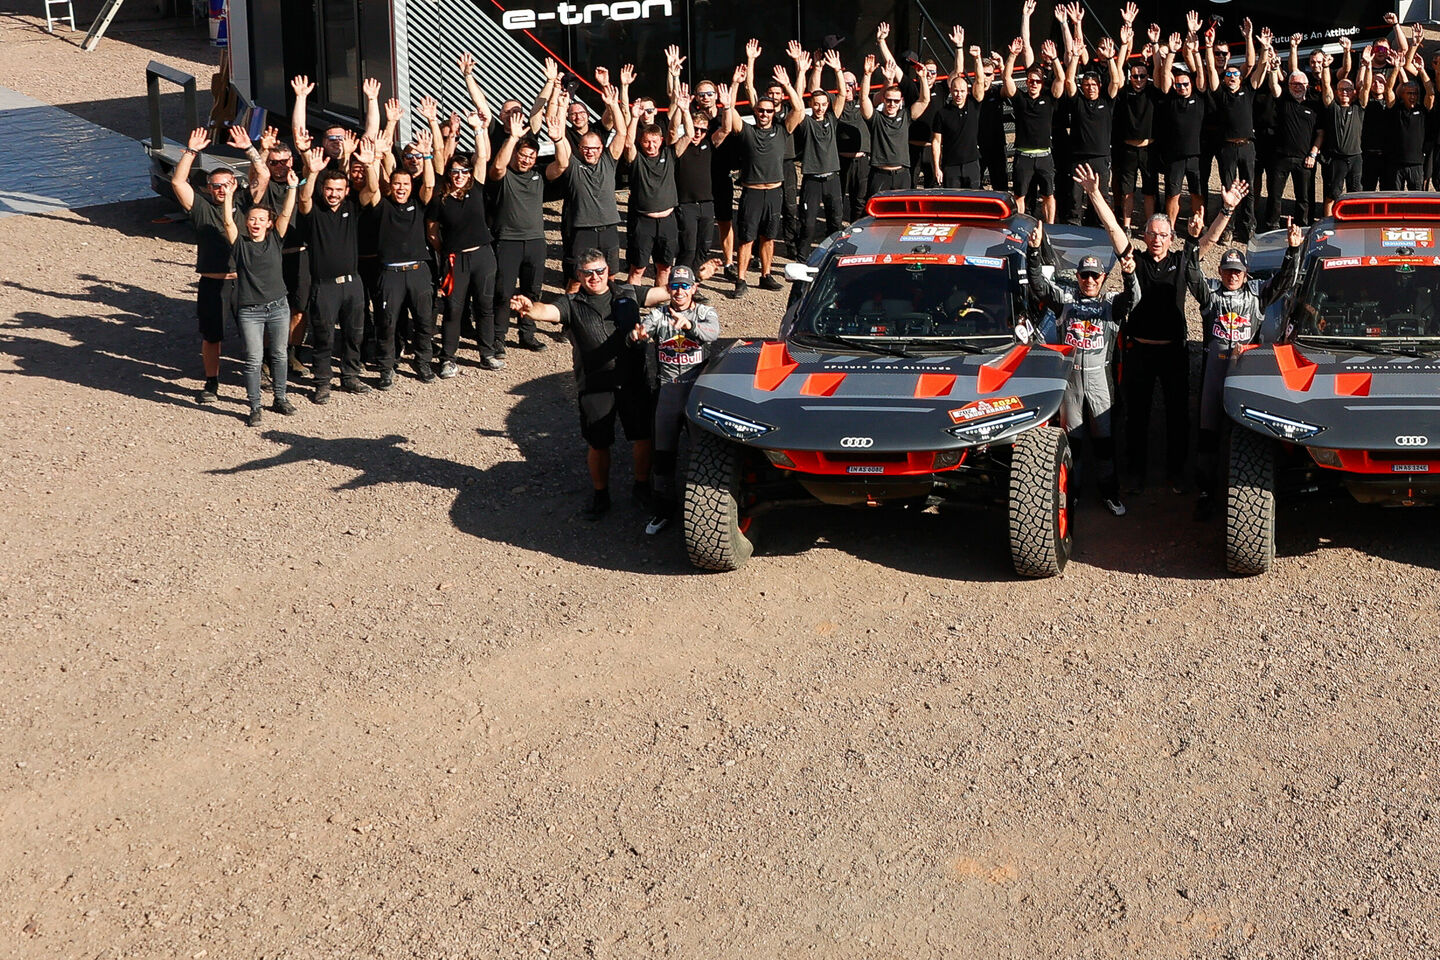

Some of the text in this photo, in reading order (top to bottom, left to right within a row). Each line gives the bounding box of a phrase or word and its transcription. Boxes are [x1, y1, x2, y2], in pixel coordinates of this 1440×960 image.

[1310, 31, 1323, 40] An
[1324, 25, 1361, 38] Attitude
[908, 226, 949, 236] 202
[1386, 231, 1428, 240] 204
[841, 256, 875, 264] MOTUL
[966, 257, 1001, 266] aramco
[1326, 259, 1359, 267] MOTUL
[1213, 324, 1251, 342] Red Bull
[1065, 333, 1104, 350] Red Bull
[659, 350, 703, 365] Red Bull
[992, 397, 1018, 407] 2024
